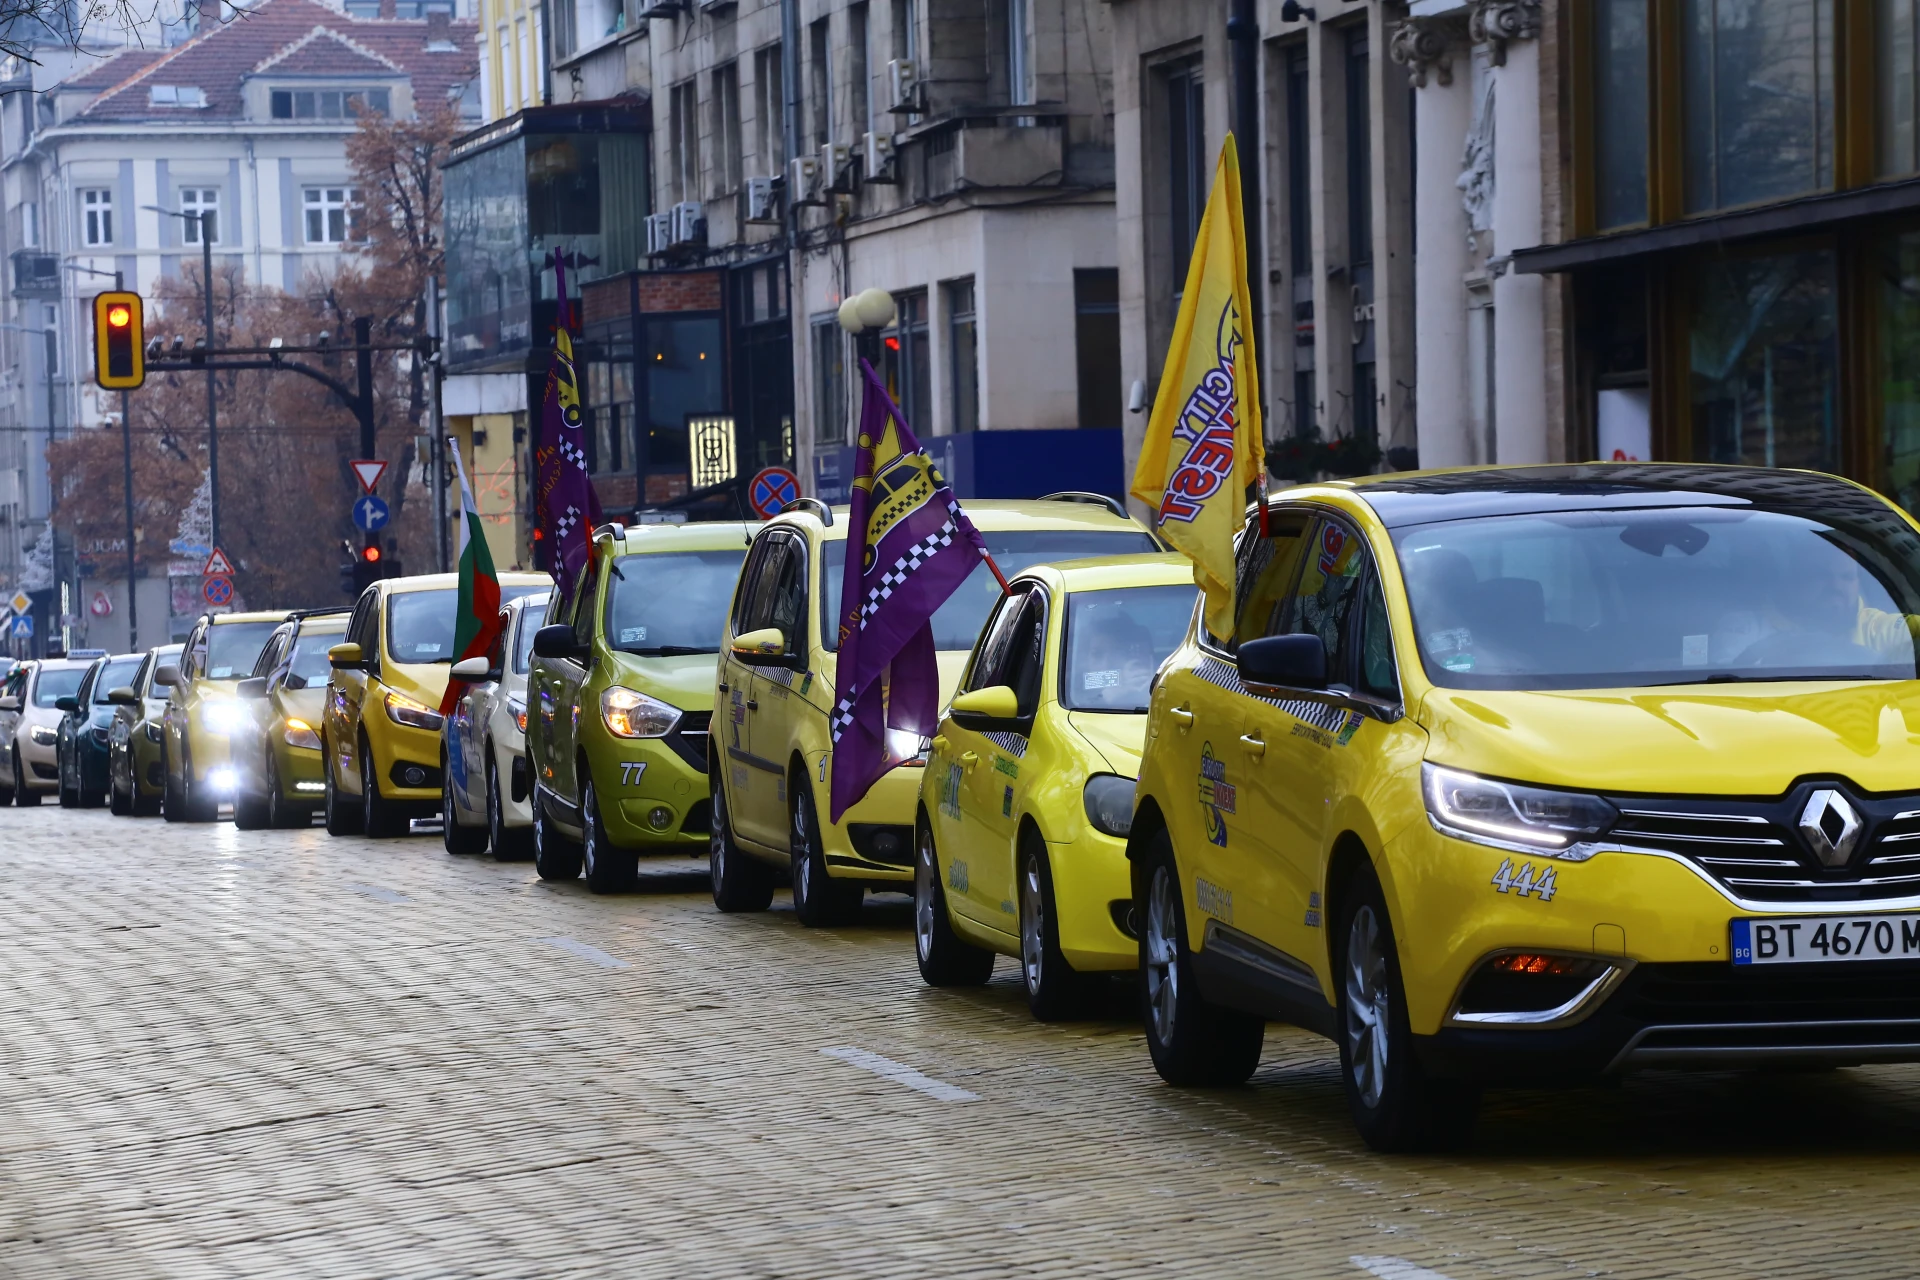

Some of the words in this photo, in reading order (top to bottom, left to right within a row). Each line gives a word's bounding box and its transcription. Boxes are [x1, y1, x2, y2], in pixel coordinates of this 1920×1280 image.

[620, 761, 647, 786] 77
[819, 754, 827, 782] 1
[1491, 857, 1558, 902] 444
[1735, 948, 1750, 958] BG
[1756, 924, 1801, 958] BT
[1810, 921, 1894, 956] 4670
